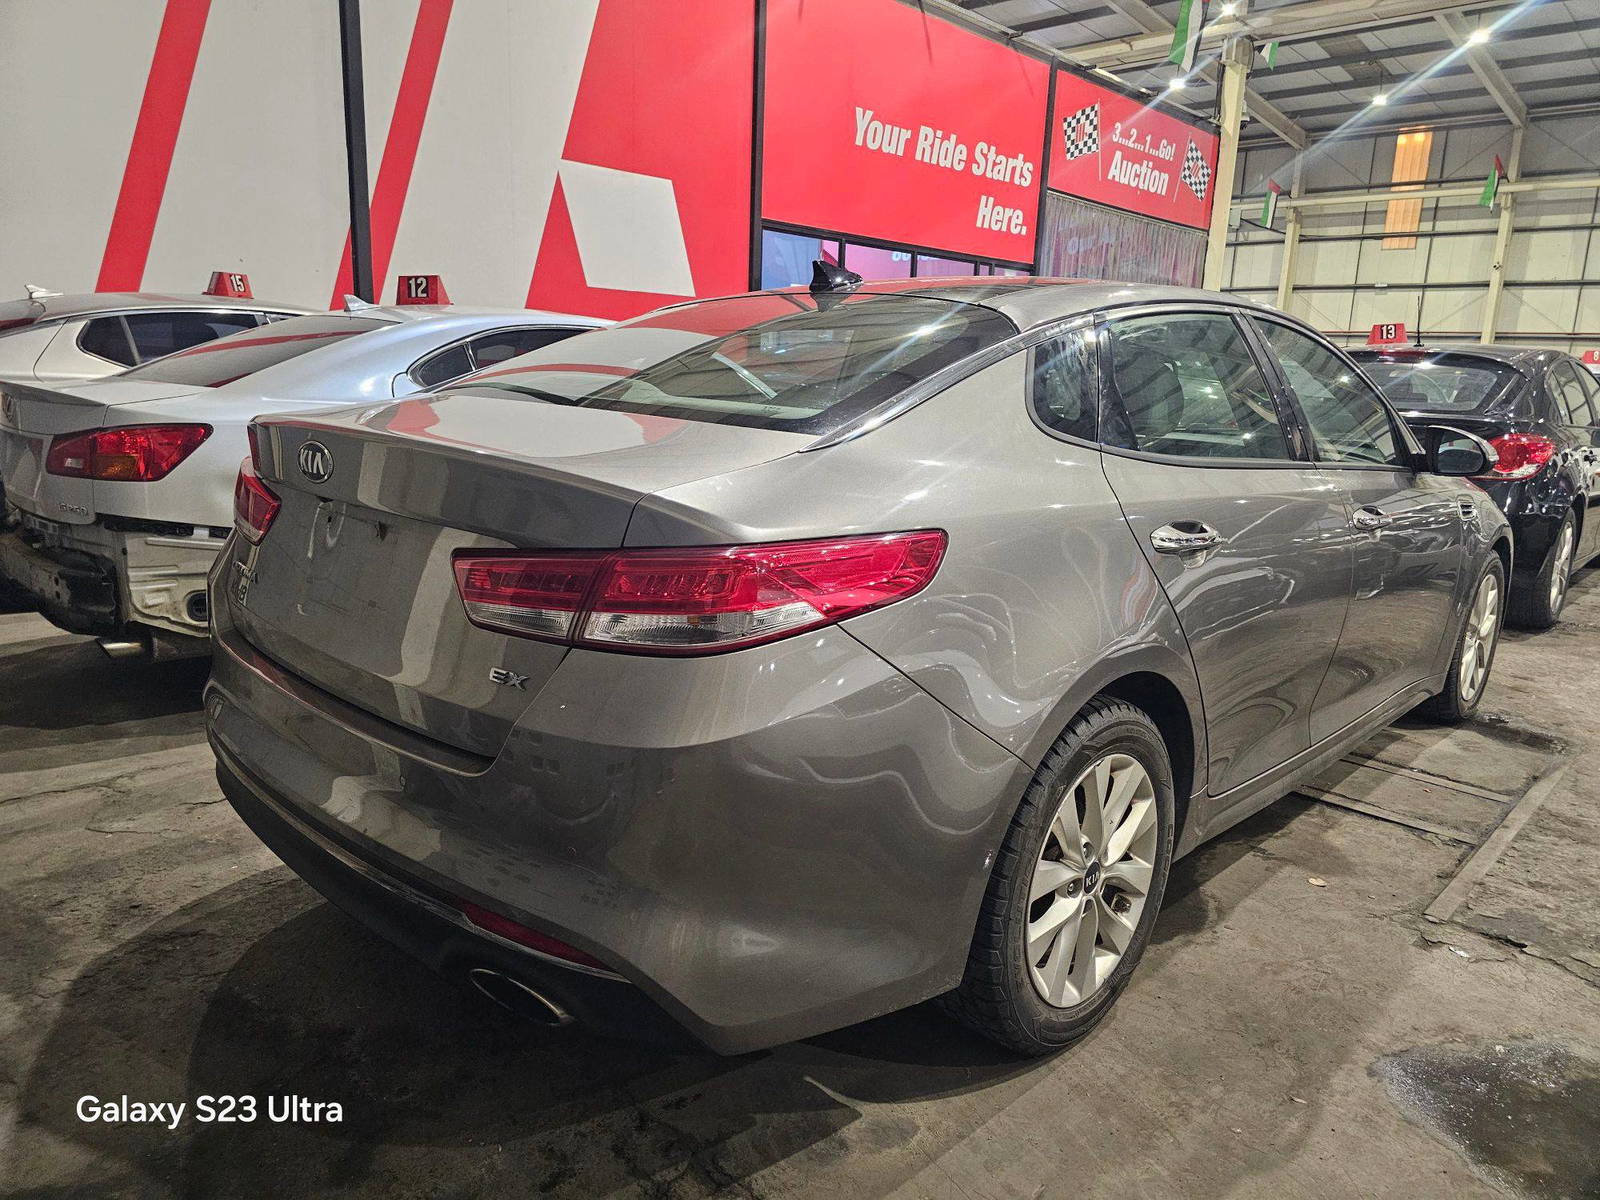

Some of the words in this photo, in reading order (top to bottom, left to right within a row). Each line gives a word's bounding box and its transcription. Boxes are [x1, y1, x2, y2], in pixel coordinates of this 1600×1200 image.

[855, 106, 912, 157] Your
[914, 125, 968, 172] Ride
[971, 141, 1034, 188] Starts
[1107, 150, 1170, 196] Auction
[976, 195, 1028, 236] Here.
[230, 274, 245, 293] 15
[408, 276, 428, 298] 12
[1381, 325, 1396, 340] 13
[300, 448, 325, 476] KIA
[489, 667, 530, 692] EX
[1085, 871, 1100, 888] KIA
